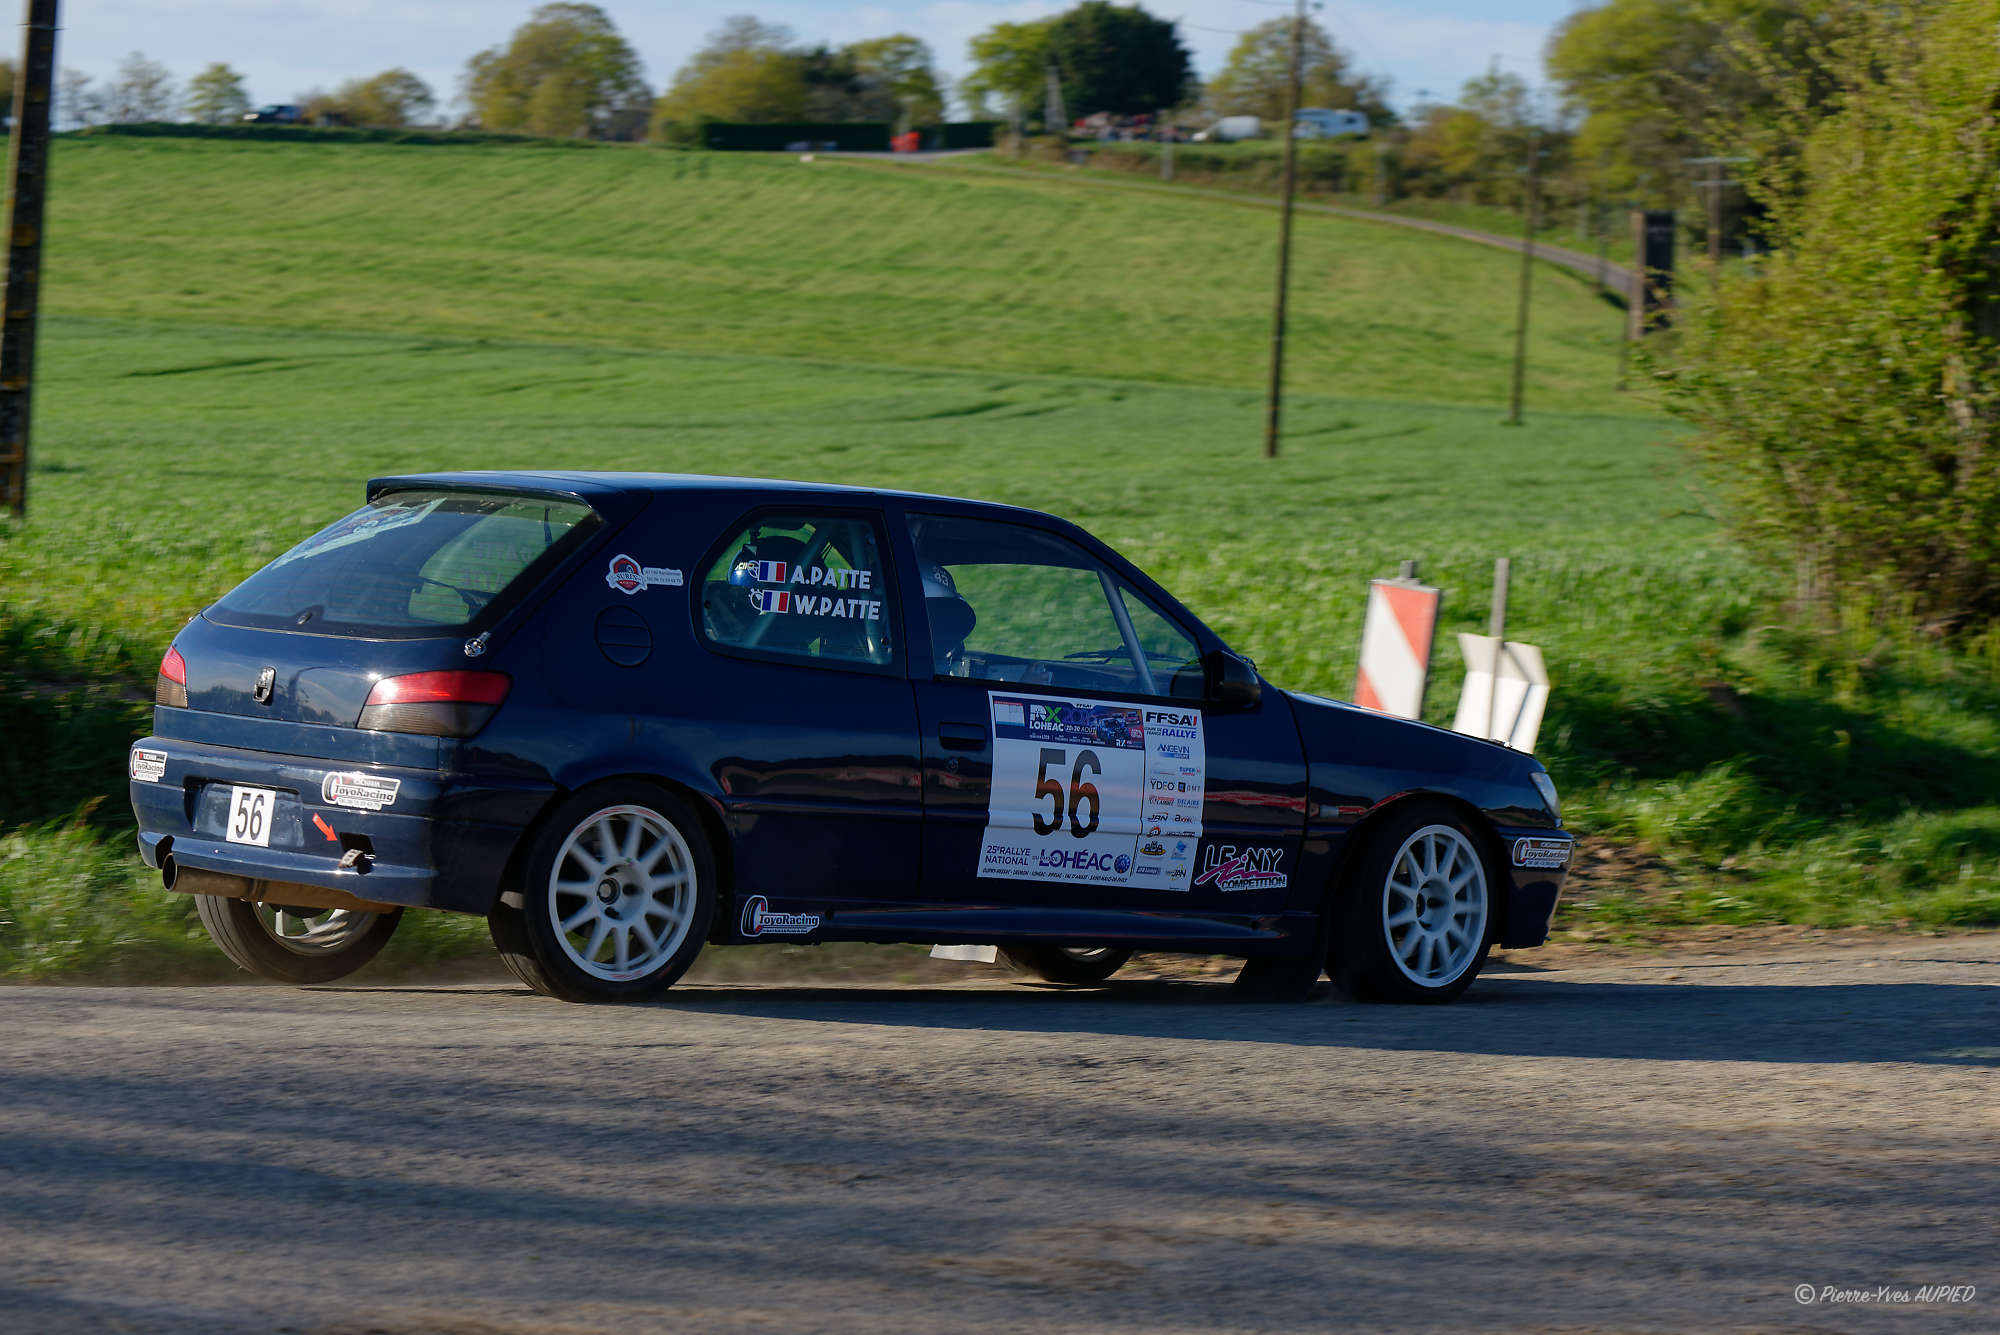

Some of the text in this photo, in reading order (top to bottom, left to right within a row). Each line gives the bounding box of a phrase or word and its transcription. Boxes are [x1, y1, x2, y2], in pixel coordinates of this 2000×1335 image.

[790, 565, 871, 590] A.PATTE
[794, 594, 881, 620] W.PATTE
[1145, 711, 1192, 726] FFSA
[1162, 728, 1197, 739] RALLYE
[335, 785, 394, 801] ToyoRacing
[1032, 747, 1102, 839] 56
[235, 791, 265, 841] 56
[1000, 846, 1031, 856] RALLYE
[984, 855, 1029, 866] NATIONAL
[1039, 848, 1114, 872] LOHÉAC
[1221, 874, 1288, 891] COMPETITION
[760, 913, 819, 926] ToyoRacing
